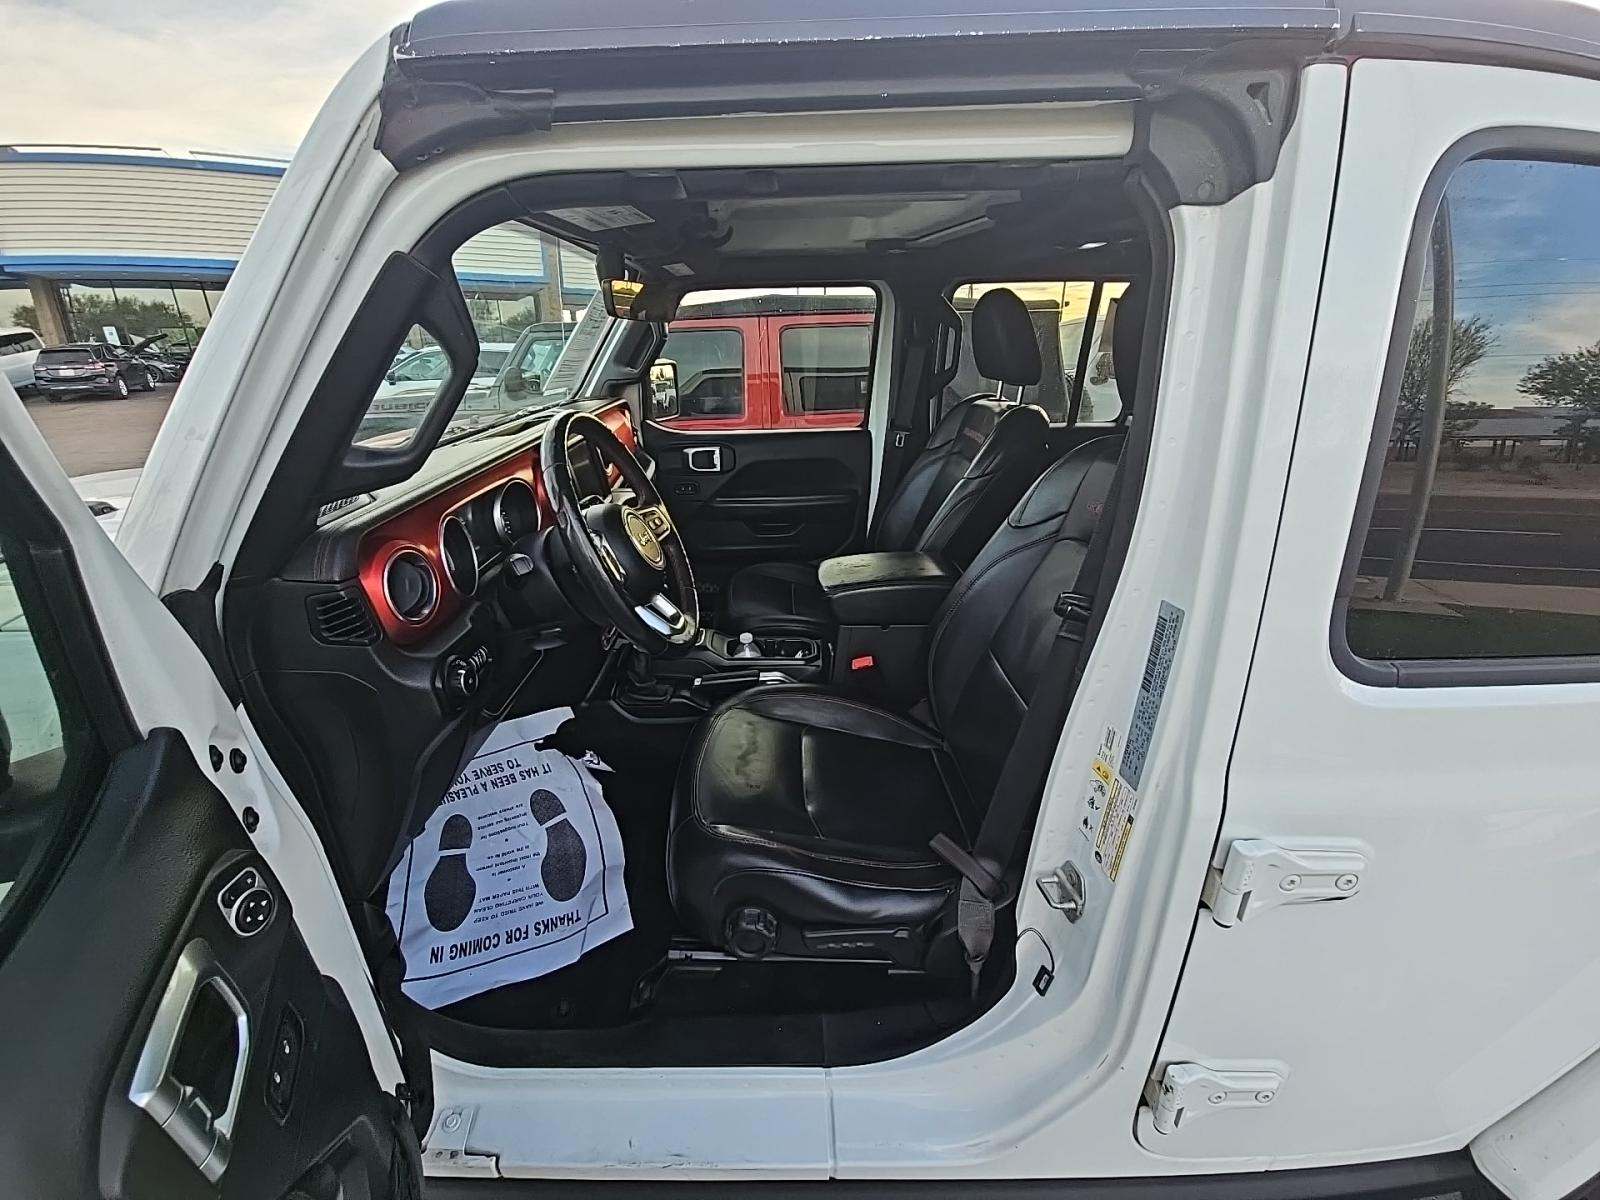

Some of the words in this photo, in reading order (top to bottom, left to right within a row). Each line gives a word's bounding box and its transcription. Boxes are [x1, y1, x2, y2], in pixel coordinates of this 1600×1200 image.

[506, 758, 521, 769] TO
[542, 763, 552, 774] IT
[471, 762, 504, 780] SERVE
[518, 766, 539, 781] HAS
[455, 773, 470, 786] YO
[490, 773, 517, 789] BEEN
[480, 781, 486, 792] A
[495, 857, 518, 867] important
[492, 891, 510, 899] PAPER
[474, 905, 493, 913] CLEAN
[501, 908, 516, 916] TRIED
[535, 910, 581, 936] THANKS
[505, 925, 528, 944] FOR
[450, 933, 500, 961] COMING
[430, 946, 443, 964] IN
